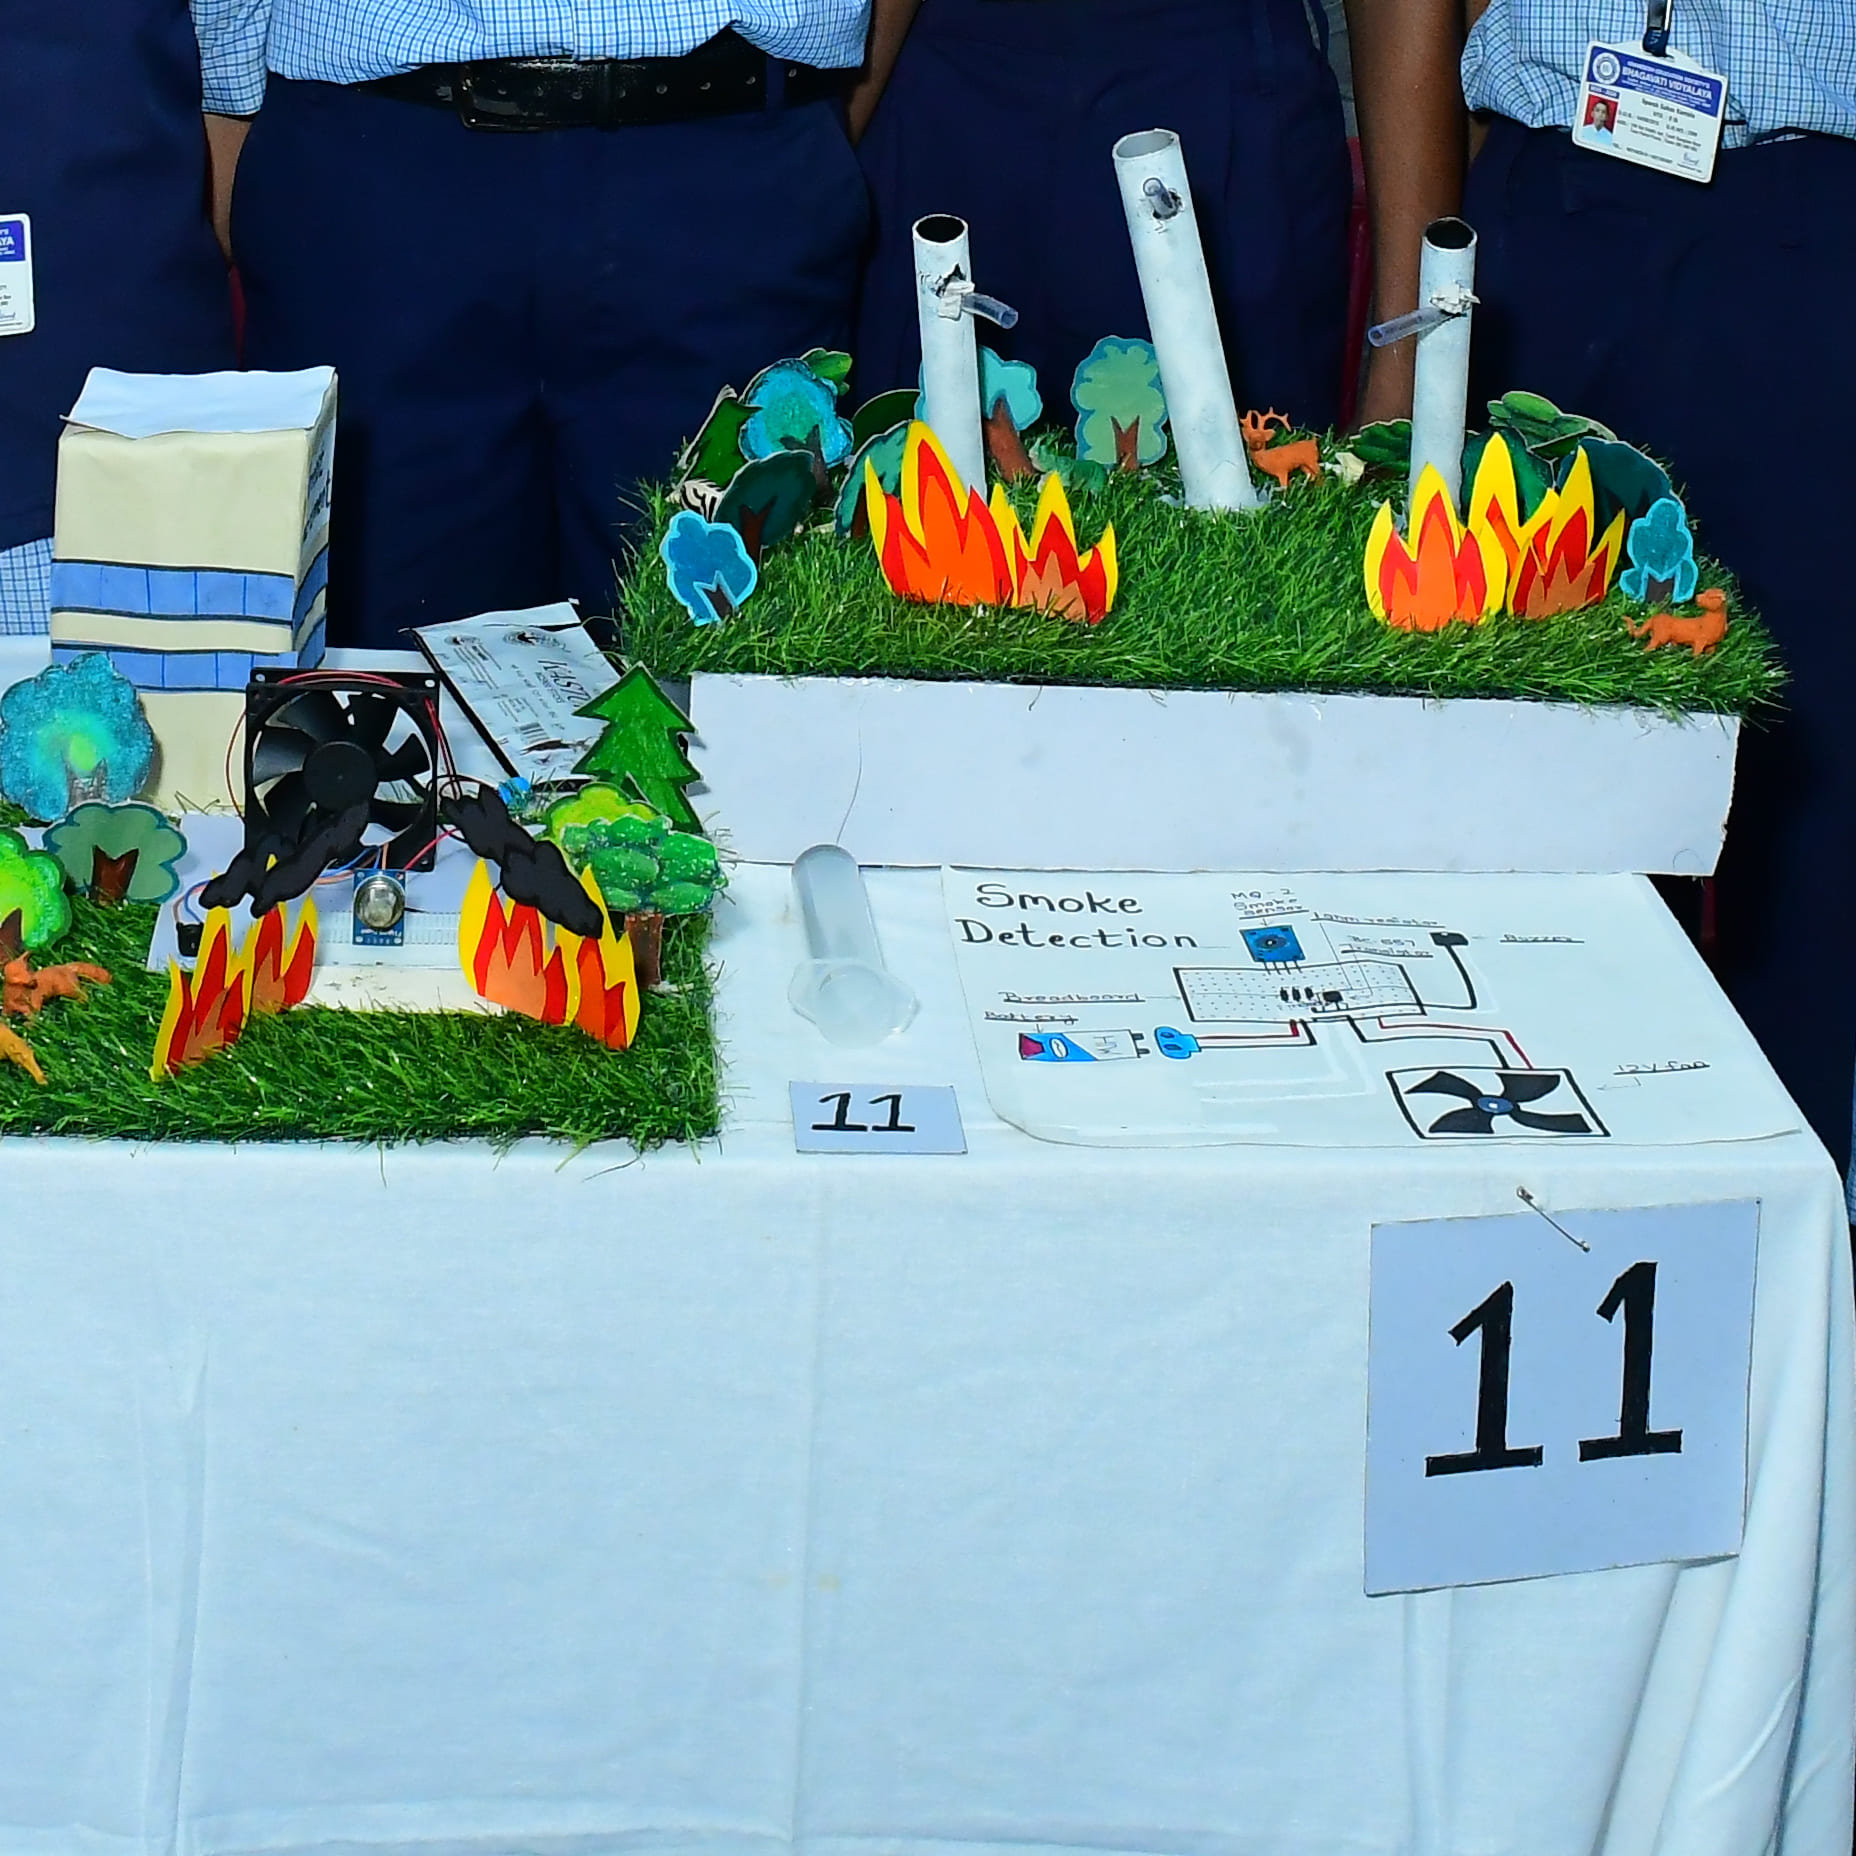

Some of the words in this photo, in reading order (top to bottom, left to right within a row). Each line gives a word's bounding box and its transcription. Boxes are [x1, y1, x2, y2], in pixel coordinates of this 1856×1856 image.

[976, 883, 1144, 915] Smoke
[956, 918, 1199, 949] Detection
[812, 1092, 916, 1133] 11
[1425, 1261, 1683, 1478] 11
